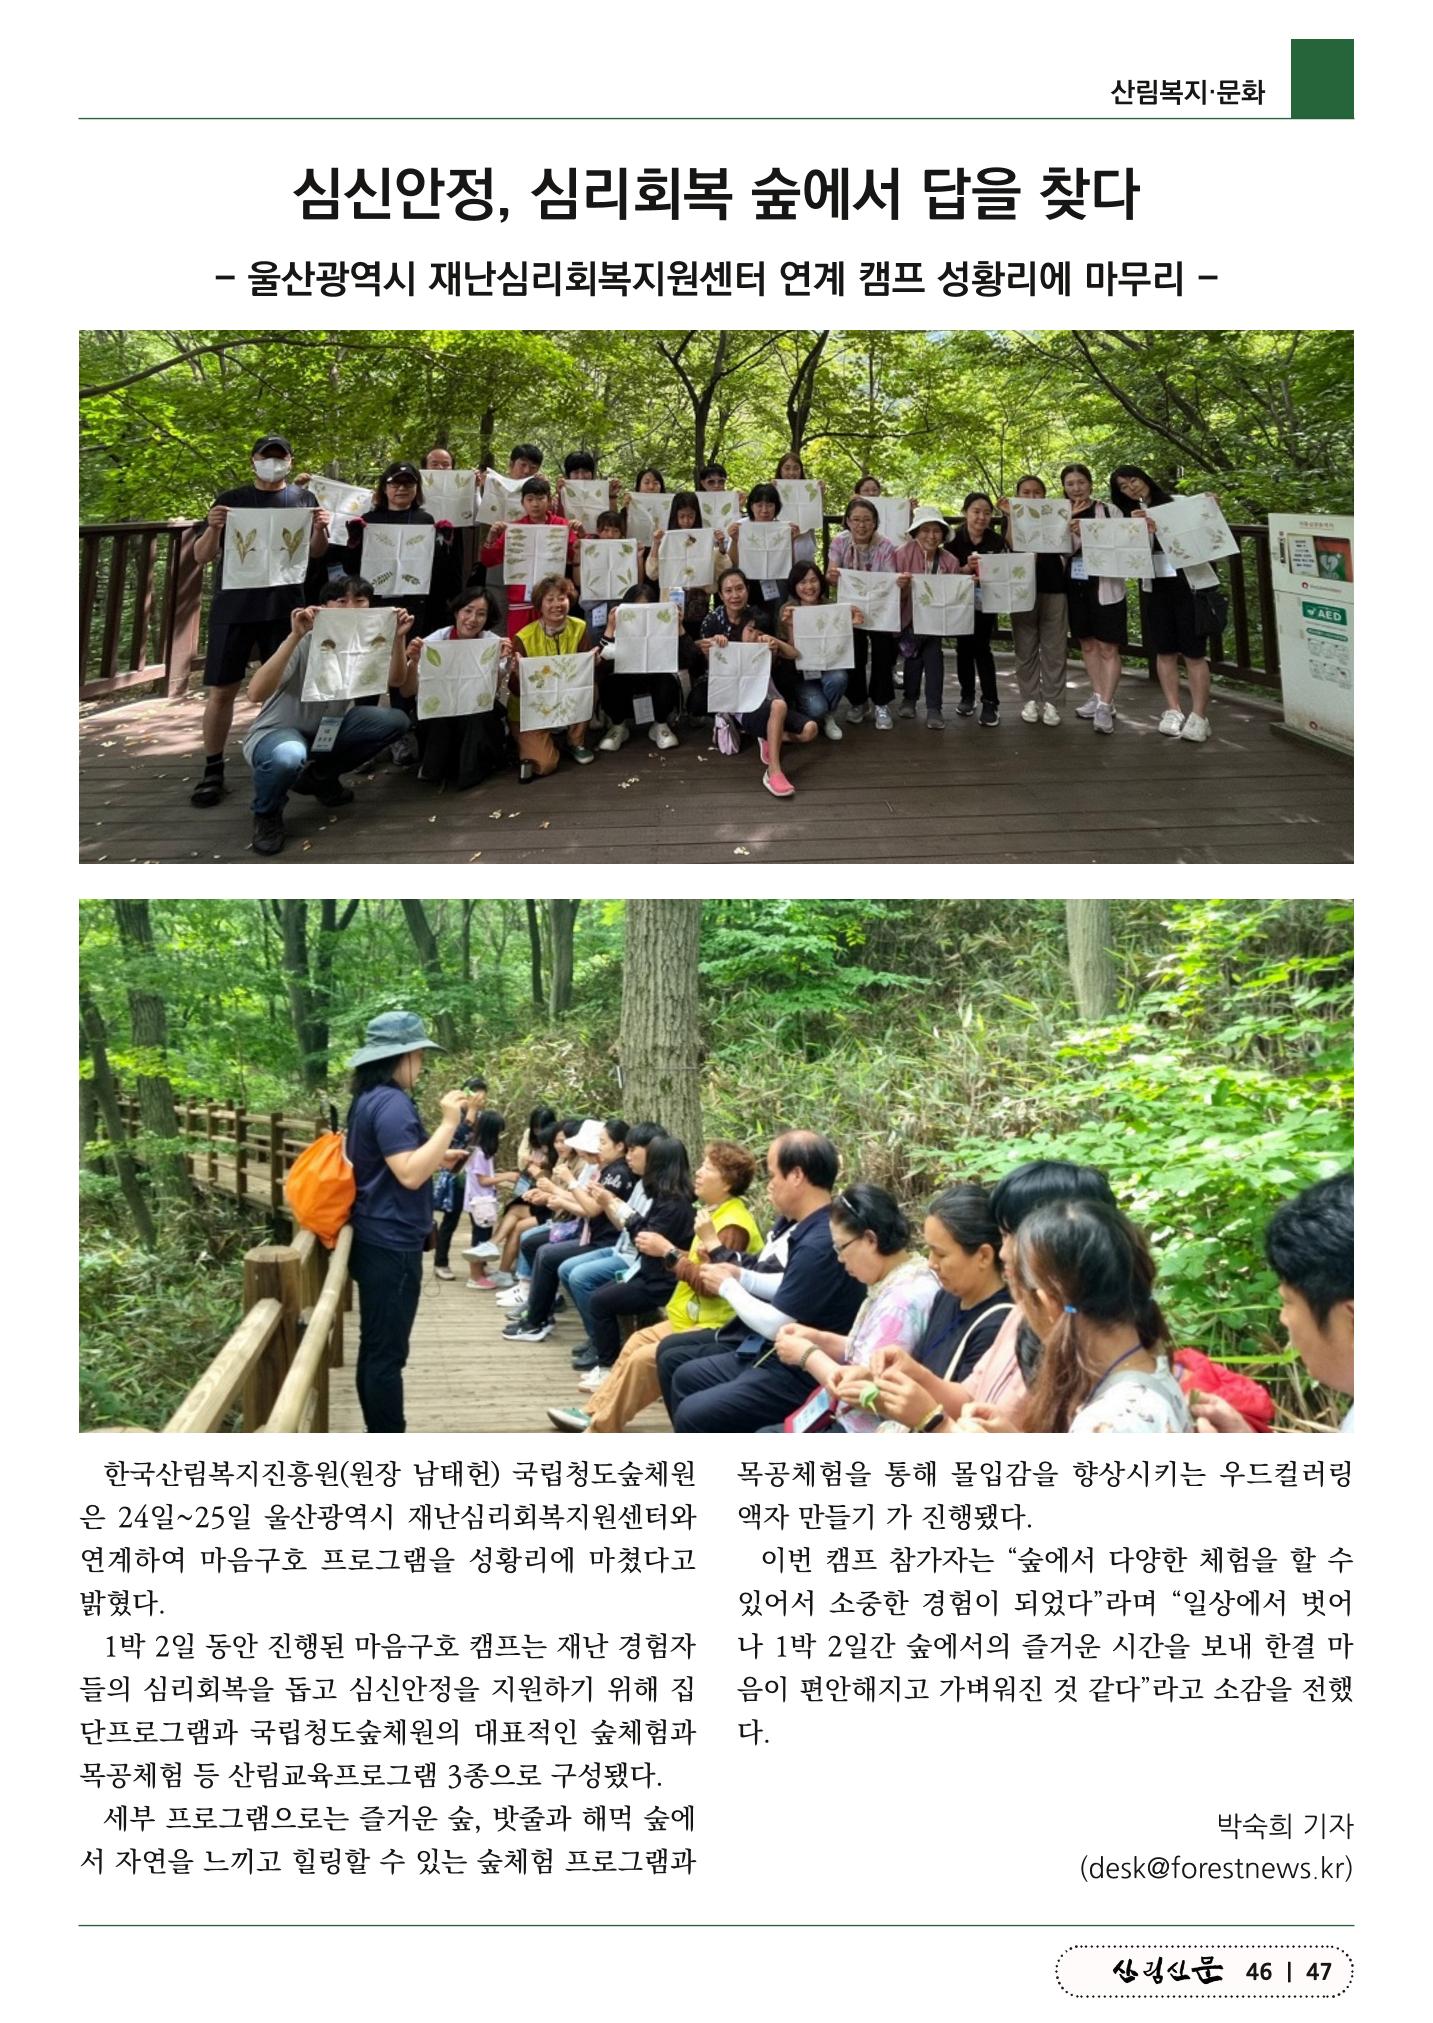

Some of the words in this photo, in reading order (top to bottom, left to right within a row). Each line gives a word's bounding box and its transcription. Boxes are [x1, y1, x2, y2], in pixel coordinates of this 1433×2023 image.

[1110, 79, 1266, 106] 산림복지·문화
[292, 167, 509, 224] 심신안정,
[530, 167, 733, 221] 심리회복
[751, 167, 899, 221] 숲에서
[924, 166, 1022, 221] 답을
[1039, 166, 1141, 221] 찾다
[247, 260, 415, 298] 울산광역시
[428, 260, 765, 297] 재난심리회복지원센터
[780, 260, 844, 297] 연계
[858, 260, 926, 297] 캠프
[937, 260, 1071, 298] 성황리에
[1086, 260, 1183, 297] 마무리
[1317, 609, 1342, 622] AED
[103, 1460, 402, 1489] 한국산림복지진흥원(원장
[413, 1460, 500, 1489] 남태헌)
[512, 1460, 696, 1488] 국립청도숲체원
[737, 1460, 872, 1488] 목공체험을
[884, 1460, 936, 1488] 통해
[951, 1460, 1059, 1488] 몰입감을
[1072, 1460, 1207, 1488] 향상시키는
[1219, 1460, 1351, 1488] 우드컬러링
[79, 1504, 106, 1530] 은
[118, 1503, 251, 1530] 24일~25일
[264, 1503, 393, 1531] 울산광역시
[408, 1503, 697, 1531] 재난심리회복지원센터와
[738, 1503, 790, 1531] 액자
[798, 1503, 874, 1531] 만들기
[886, 1503, 913, 1531] 가
[922, 1503, 1032, 1531] 진행됐다.
[81, 1546, 184, 1574] 연계하여
[200, 1546, 308, 1574] 마음구호
[321, 1546, 455, 1574] 프로그램을
[469, 1546, 574, 1574] 성황리에
[589, 1546, 696, 1574] 마쳤다고
[762, 1546, 812, 1574] 이번
[826, 1546, 878, 1574] 캠프
[889, 1546, 995, 1574] 참가자는
[1008, 1546, 1094, 1574] “숲에서
[1109, 1546, 1188, 1574] 다양한
[1199, 1546, 1278, 1574] 체험을
[1290, 1546, 1317, 1574] 할
[1327, 1546, 1354, 1574] 수
[79, 1589, 164, 1617] 밝혔다.
[739, 1589, 814, 1617] 있어서
[829, 1589, 910, 1617] 소중한
[922, 1589, 998, 1617] 경험이
[1014, 1589, 1155, 1617] 되었다”라며
[1172, 1589, 1286, 1617] “일상에서
[1302, 1589, 1351, 1617] 벗어
[106, 1632, 146, 1660] 1박
[155, 1632, 195, 1660] 2일
[205, 1632, 259, 1660] 동안
[268, 1632, 345, 1660] 진행된
[354, 1632, 460, 1660] 마음구호
[469, 1632, 548, 1660] 캠프는
[556, 1632, 609, 1660] 재난
[618, 1632, 697, 1660] 경험자
[737, 1632, 764, 1660] 나
[776, 1632, 817, 1660] 1박
[828, 1632, 896, 1660] 2일간
[906, 1632, 1009, 1660] 숲에서의
[1021, 1632, 1101, 1660] 즐거운
[1112, 1632, 1190, 1660] 시간을
[1201, 1632, 1251, 1660] 보내
[1264, 1632, 1315, 1660] 한결
[1327, 1632, 1354, 1660] 마
[79, 1675, 130, 1703] 들의
[143, 1675, 275, 1703] 심리회복을
[285, 1676, 338, 1703] 돕고
[349, 1675, 480, 1703] 심신안정을
[491, 1675, 592, 1703] 지원하기
[607, 1675, 657, 1703] 위해
[671, 1675, 693, 1703] 집
[737, 1675, 787, 1703] 음이
[800, 1675, 930, 1703] 편안해지고
[939, 1675, 1043, 1703] 가벼워진
[1054, 1675, 1078, 1703] 것
[1088, 1675, 1204, 1703] 같다”라고
[1213, 1675, 1292, 1703] 소감을
[1302, 1675, 1353, 1703] 전했
[80, 1718, 239, 1746] 단프로그램과
[250, 1718, 459, 1746] 국립청도숲체원의
[474, 1718, 578, 1746] 대표적인
[590, 1718, 697, 1747] 숲체험과
[737, 1718, 769, 1746] 다.
[79, 1761, 182, 1790] 목공체험
[193, 1762, 220, 1789] 등
[228, 1761, 436, 1789] 산림교육프로그램
[448, 1763, 542, 1790] 3종으로
[550, 1761, 662, 1790] 구성됐다.
[103, 1804, 156, 1833] 세부
[165, 1804, 350, 1832] 프로그램으로는
[359, 1804, 439, 1832] 즐거운
[447, 1805, 481, 1834] 숲,
[492, 1804, 572, 1833] 밧줄과
[582, 1804, 631, 1833] 해먹
[643, 1804, 694, 1833] 숲에
[1218, 1812, 1292, 1840] 박숙희
[1304, 1812, 1355, 1840] 기자
[80, 1847, 103, 1875] 서
[115, 1847, 195, 1875] 자연을
[203, 1847, 282, 1876] 느끼고
[292, 1847, 371, 1876] 힐링할
[379, 1848, 406, 1876] 수
[417, 1847, 468, 1875] 있는
[477, 1847, 553, 1876] 숲체험
[565, 1847, 697, 1875] 프로그램과
[1080, 1854, 1353, 1883] (desk@forestnews.kr)
[1245, 1962, 1273, 1981] 46
[1305, 1962, 1332, 1981] 47
